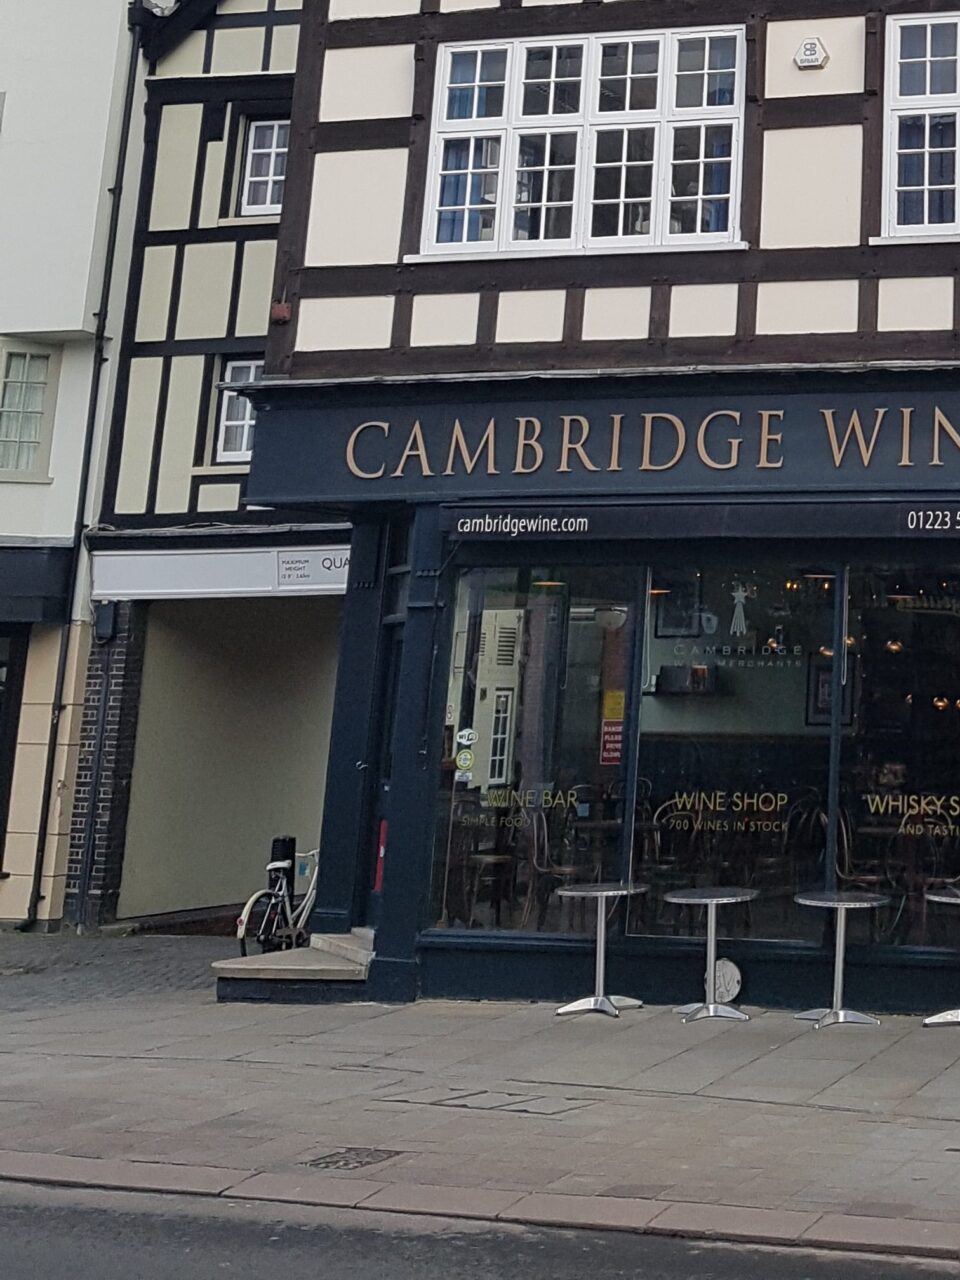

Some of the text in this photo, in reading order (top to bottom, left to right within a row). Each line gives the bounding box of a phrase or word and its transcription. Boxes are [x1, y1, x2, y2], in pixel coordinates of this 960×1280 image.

[345, 409, 785, 479] CAMBRIDGE
[457, 514, 589, 537] cambridgewine.com
[907, 511, 951, 529] 01223
[673, 644, 803, 656] CAMBRIDGE
[486, 790, 578, 808] WINE BAR
[674, 792, 788, 813] WINE SHOP
[866, 795, 946, 815] WHISKY
[668, 820, 789, 832] 700 WINES IN STOCK
[898, 824, 924, 836] AND
